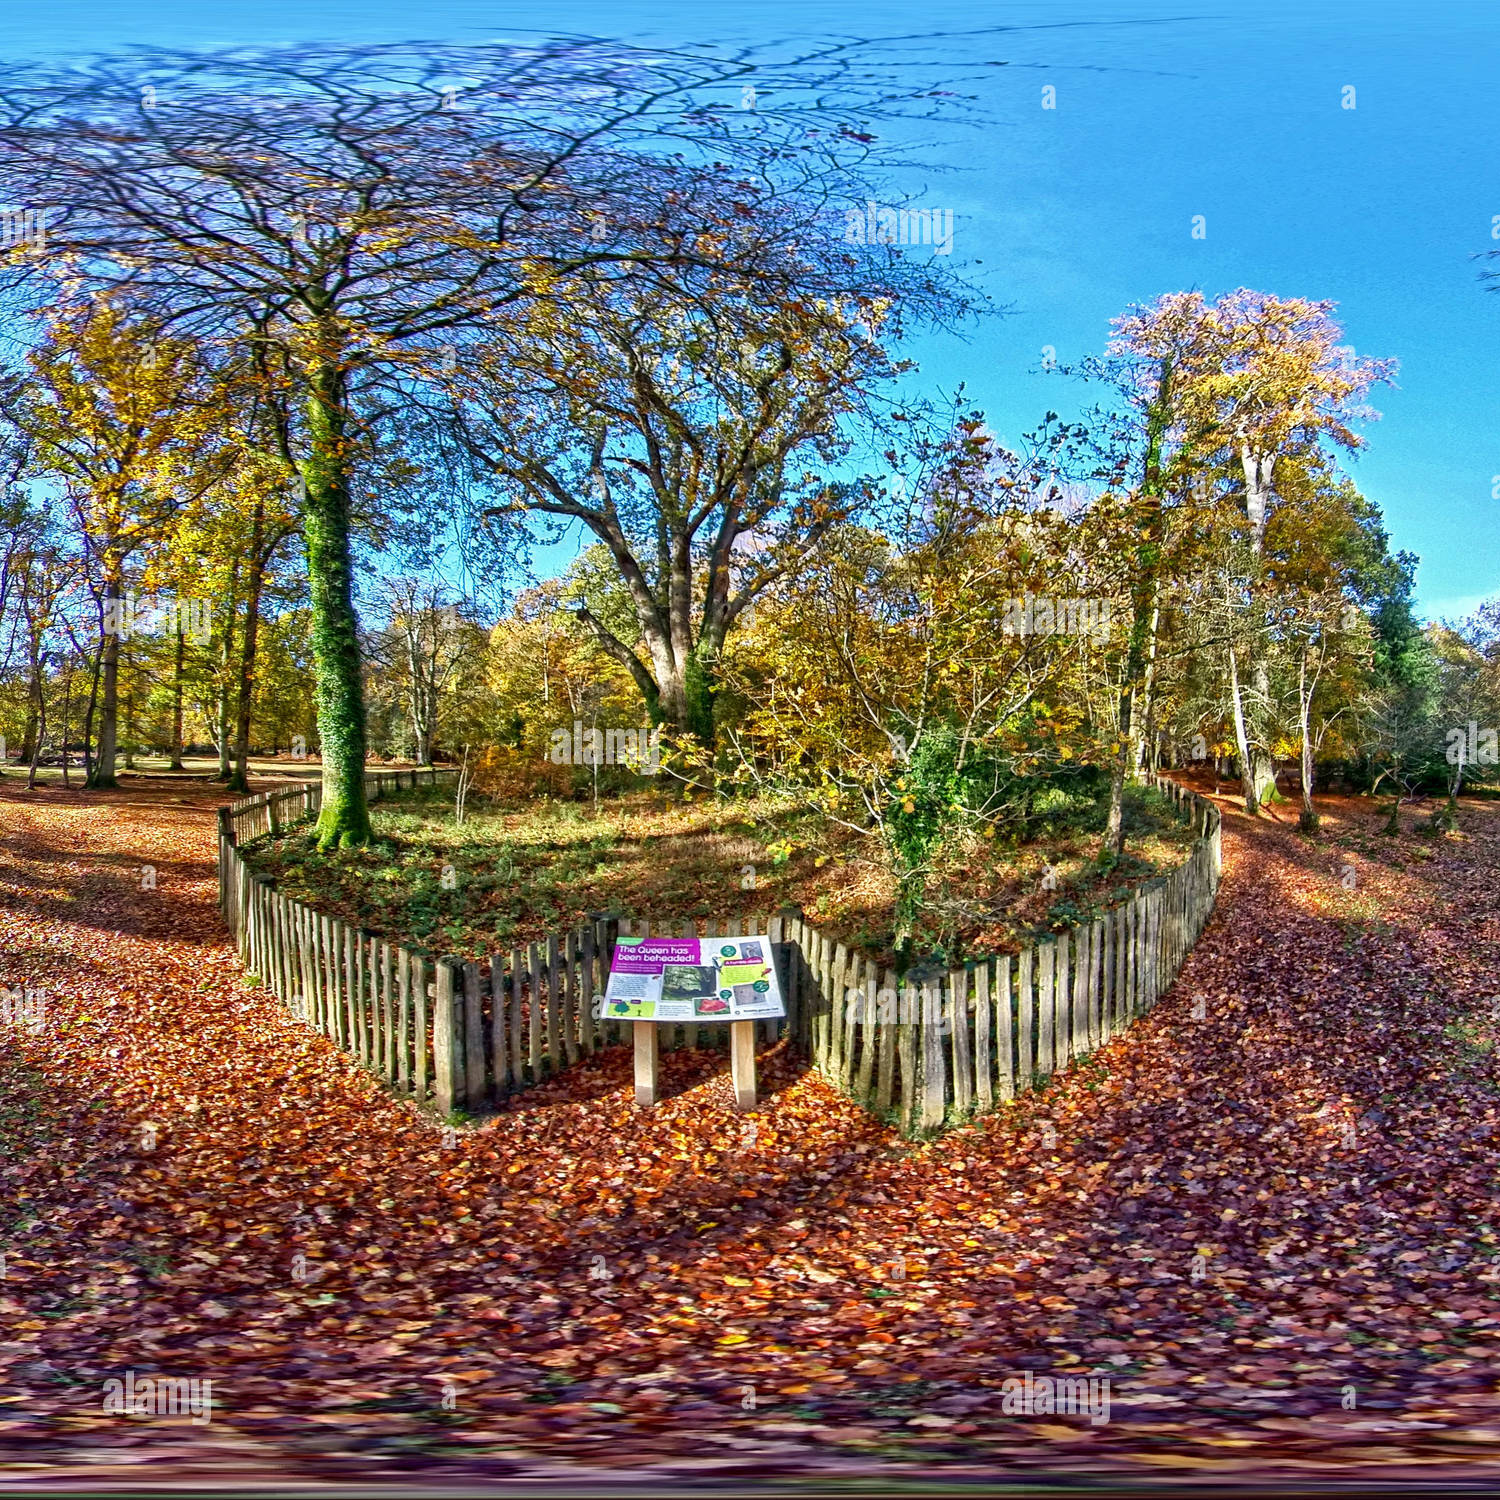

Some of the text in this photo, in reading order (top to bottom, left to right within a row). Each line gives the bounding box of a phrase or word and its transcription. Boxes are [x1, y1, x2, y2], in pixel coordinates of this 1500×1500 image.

[620, 946, 636, 954] The
[637, 946, 669, 954] Queen
[618, 953, 695, 962] been beheaded!
